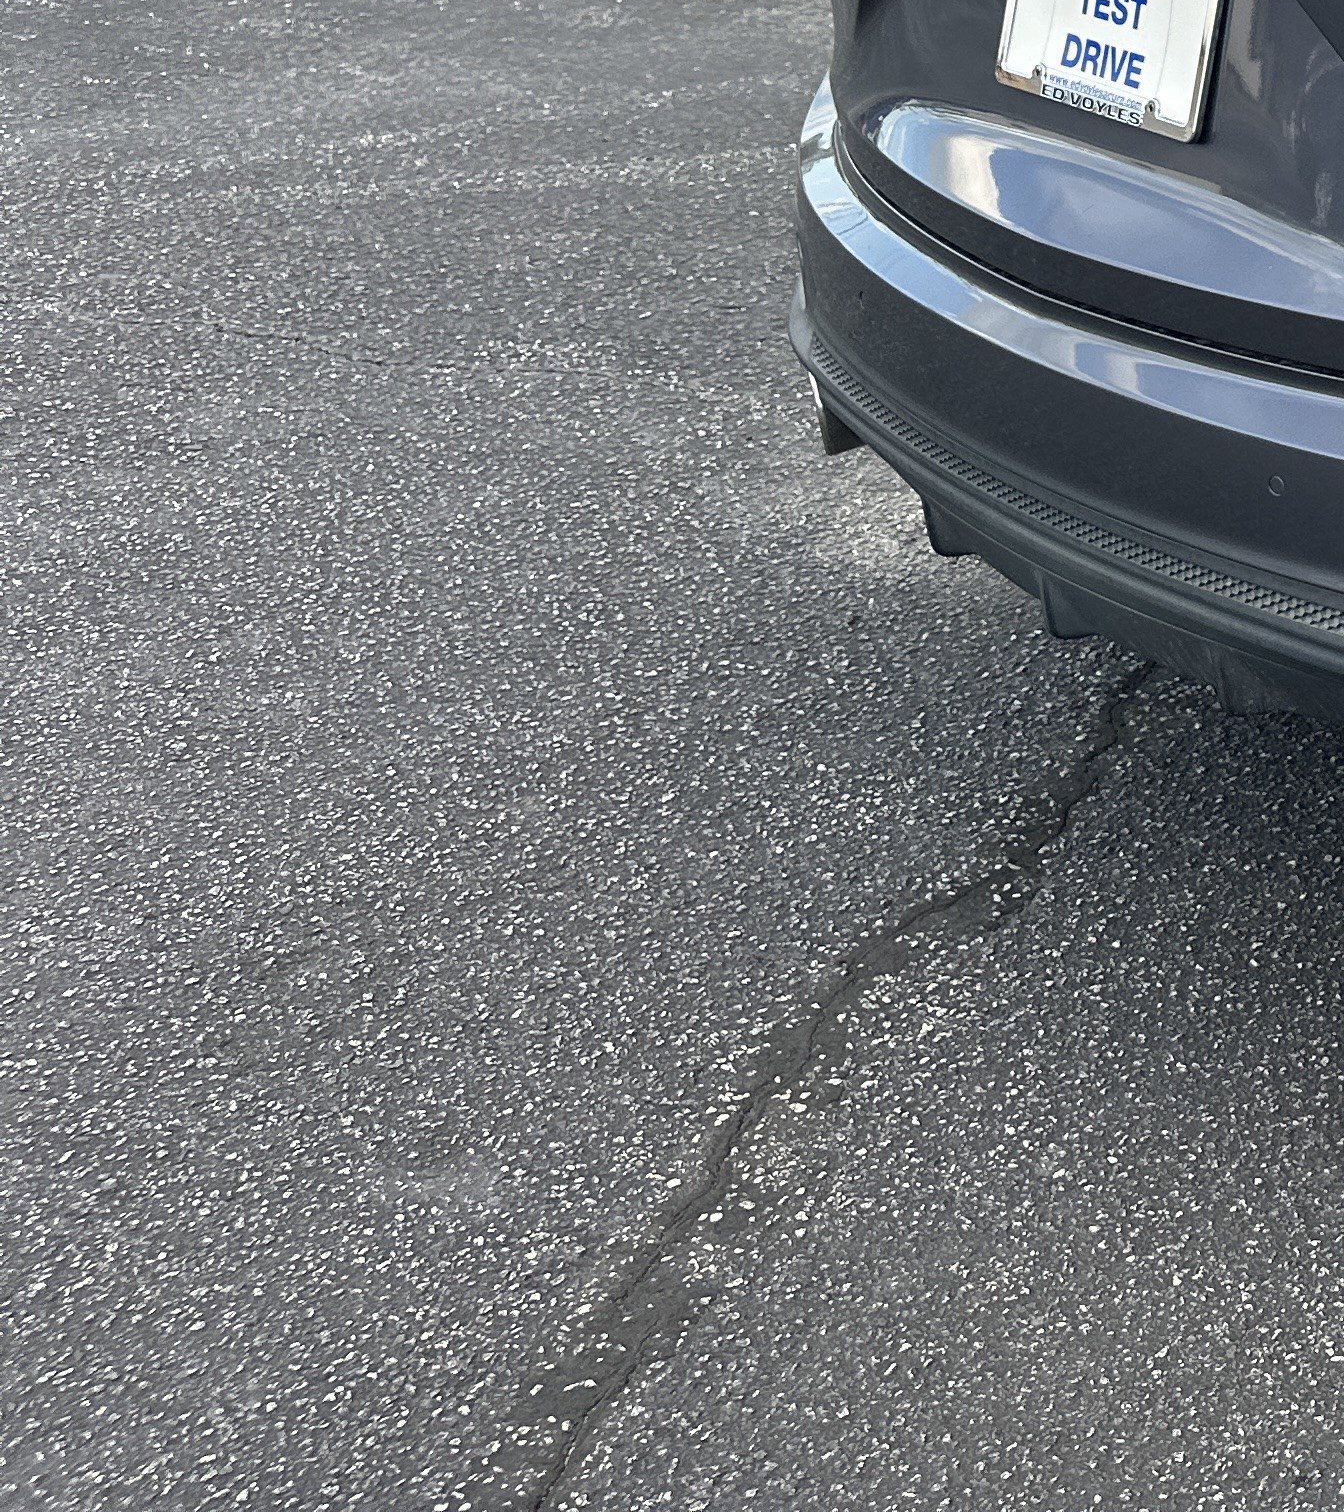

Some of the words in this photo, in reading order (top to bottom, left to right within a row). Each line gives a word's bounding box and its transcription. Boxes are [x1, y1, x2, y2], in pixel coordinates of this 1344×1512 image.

[1060, 32, 1146, 90] DRIVE
[1041, 83, 1065, 101] ED
[1070, 92, 1141, 126] VOYLES
